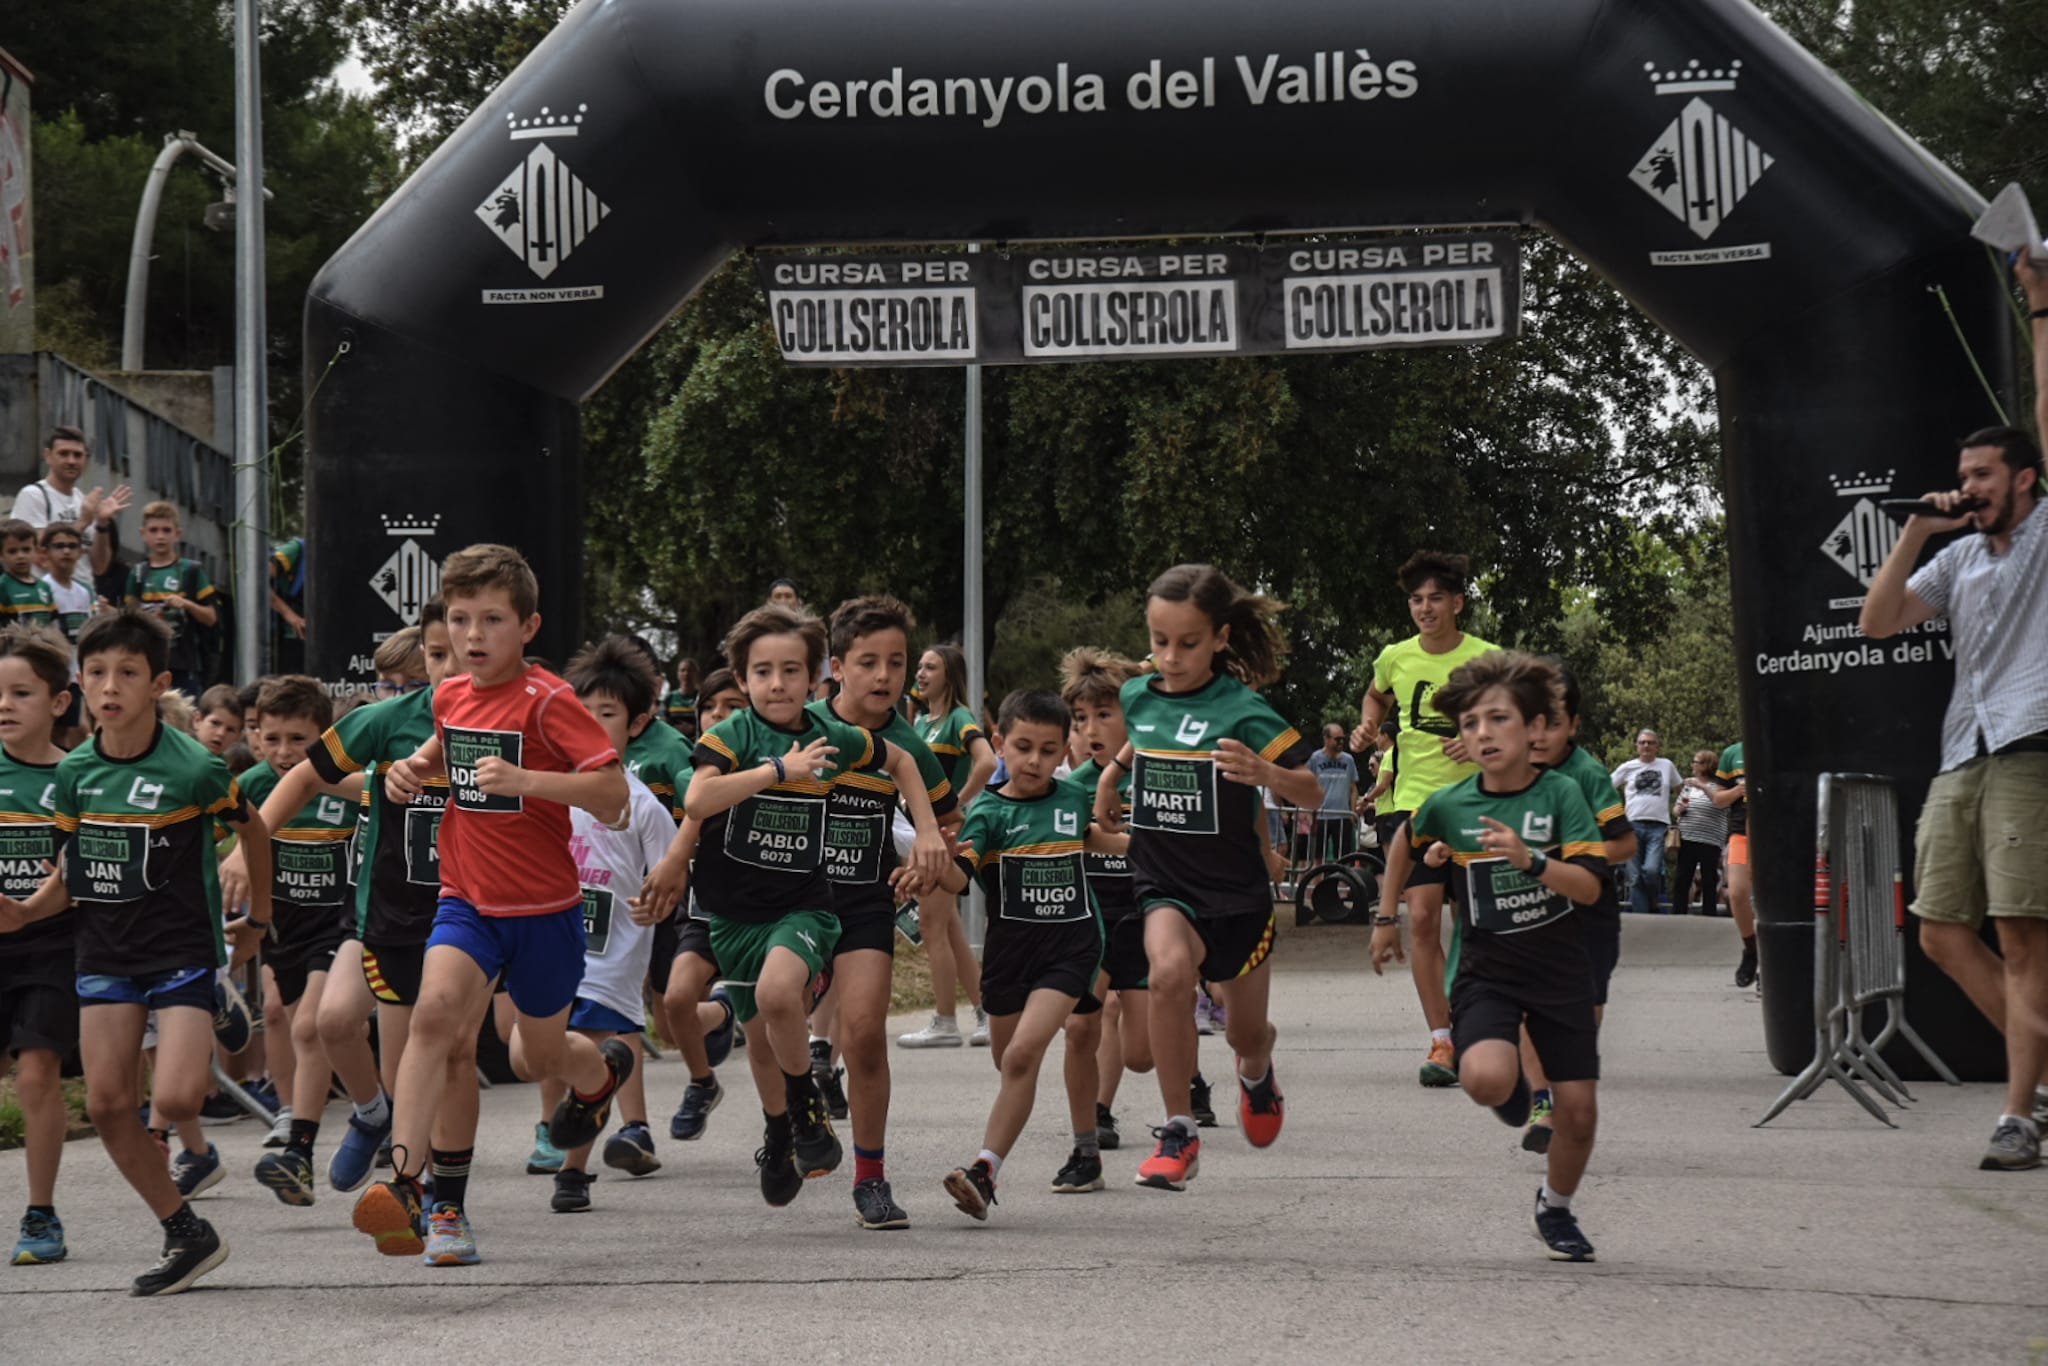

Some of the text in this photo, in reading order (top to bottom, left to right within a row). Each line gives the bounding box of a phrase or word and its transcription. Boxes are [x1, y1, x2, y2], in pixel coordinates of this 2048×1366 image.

[764, 49, 1419, 128] Cerdanyola del Vallès
[1289, 242, 1495, 272] CURSA PER
[774, 261, 970, 285] CURSA PER
[1028, 253, 1229, 280] CURSA PER
[489, 289, 598, 301] FACTA NON VERBA
[1290, 278, 1495, 341] COLLSEROLA
[776, 296, 971, 354] COLLSEROLA
[1029, 289, 1230, 349] COLLSEROLA
[1756, 645, 1885, 675] Cerdanyola
[1892, 641, 1934, 664] del
[1142, 790, 1202, 812] MARTÍ
[1156, 811, 1186, 825] 6065
[747, 830, 808, 851] PABLO
[760, 849, 793, 864] 6073
[824, 847, 862, 864] PAU
[0, 859, 48, 876] MAX
[85, 861, 123, 881] JAN
[826, 864, 856, 876] 6102
[1104, 859, 1128, 870] 6101
[93, 881, 120, 894] 6071
[276, 871, 336, 887] JULEN
[289, 888, 321, 899] 6074
[1021, 886, 1077, 903] HUGO
[1034, 904, 1066, 916] 6072
[1512, 905, 1548, 923] 6064
